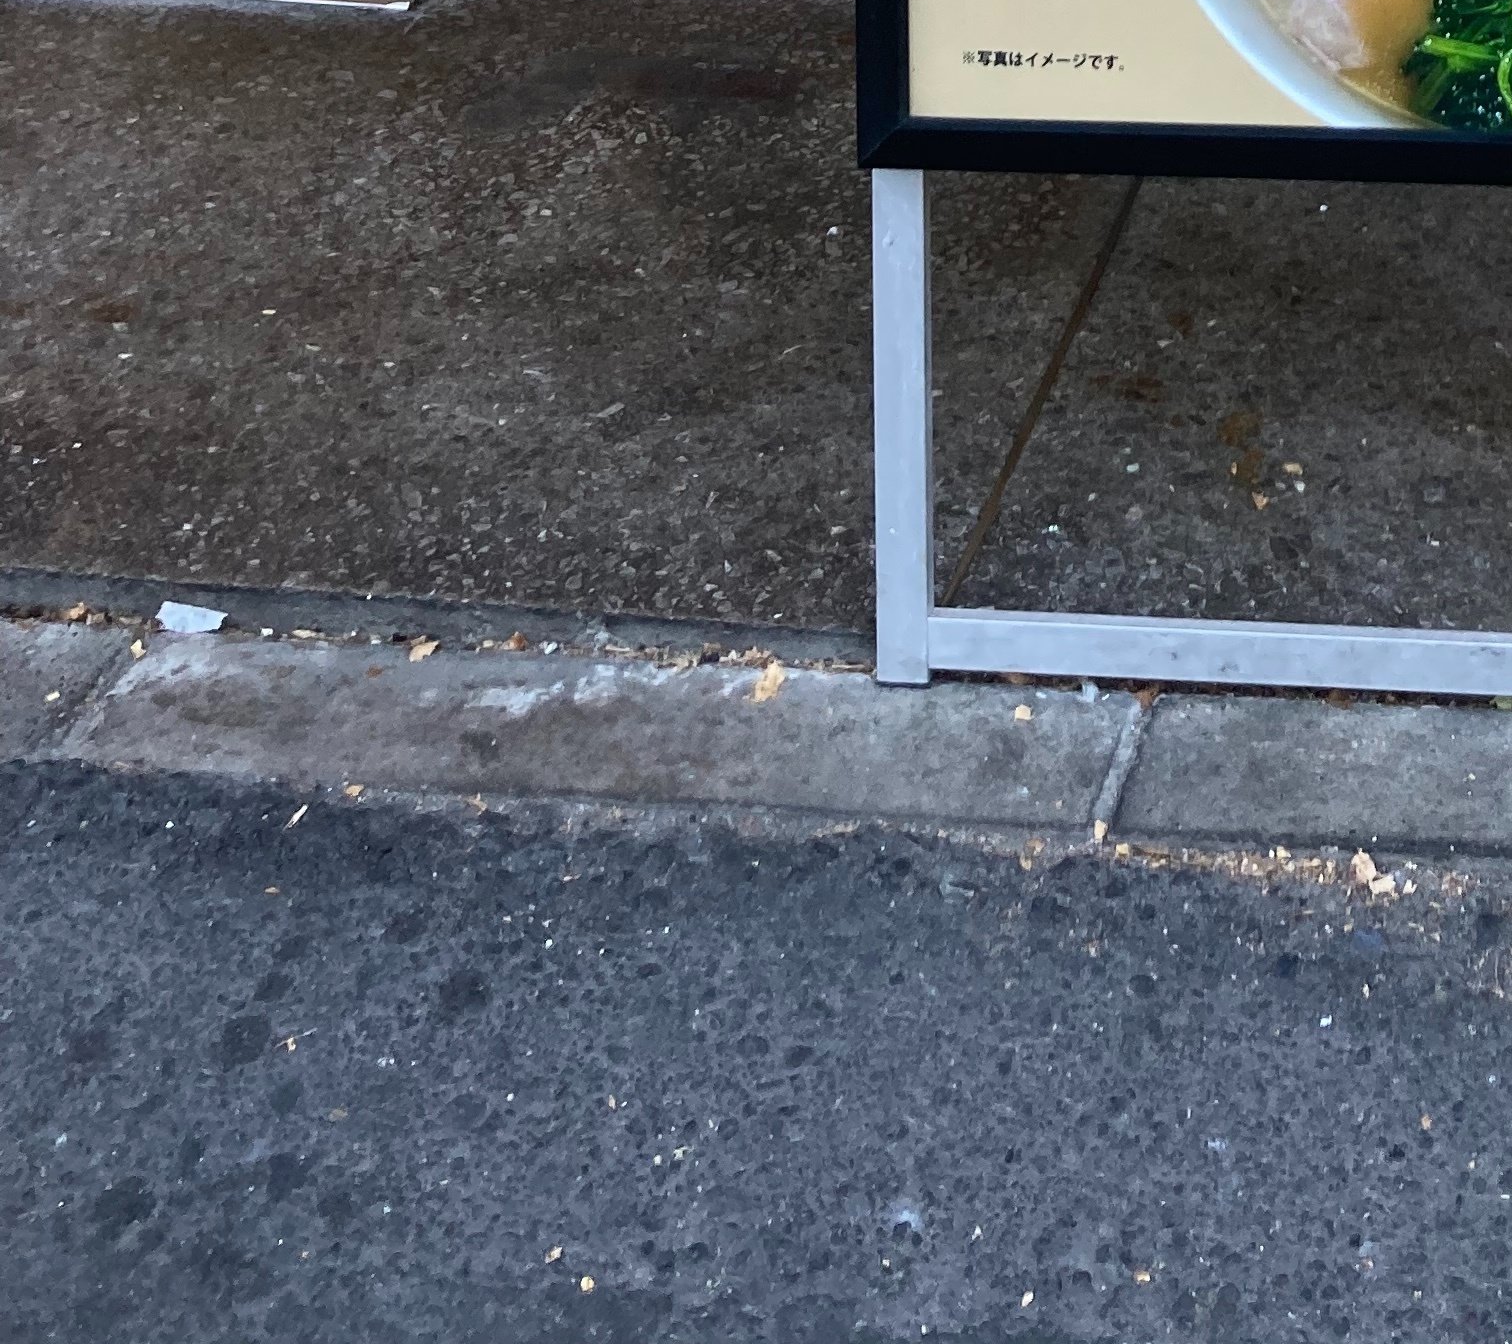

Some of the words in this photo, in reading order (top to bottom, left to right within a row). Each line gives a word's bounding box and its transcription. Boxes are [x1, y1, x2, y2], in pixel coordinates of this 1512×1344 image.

[962, 50, 1125, 71] ※写真はイメージです。
